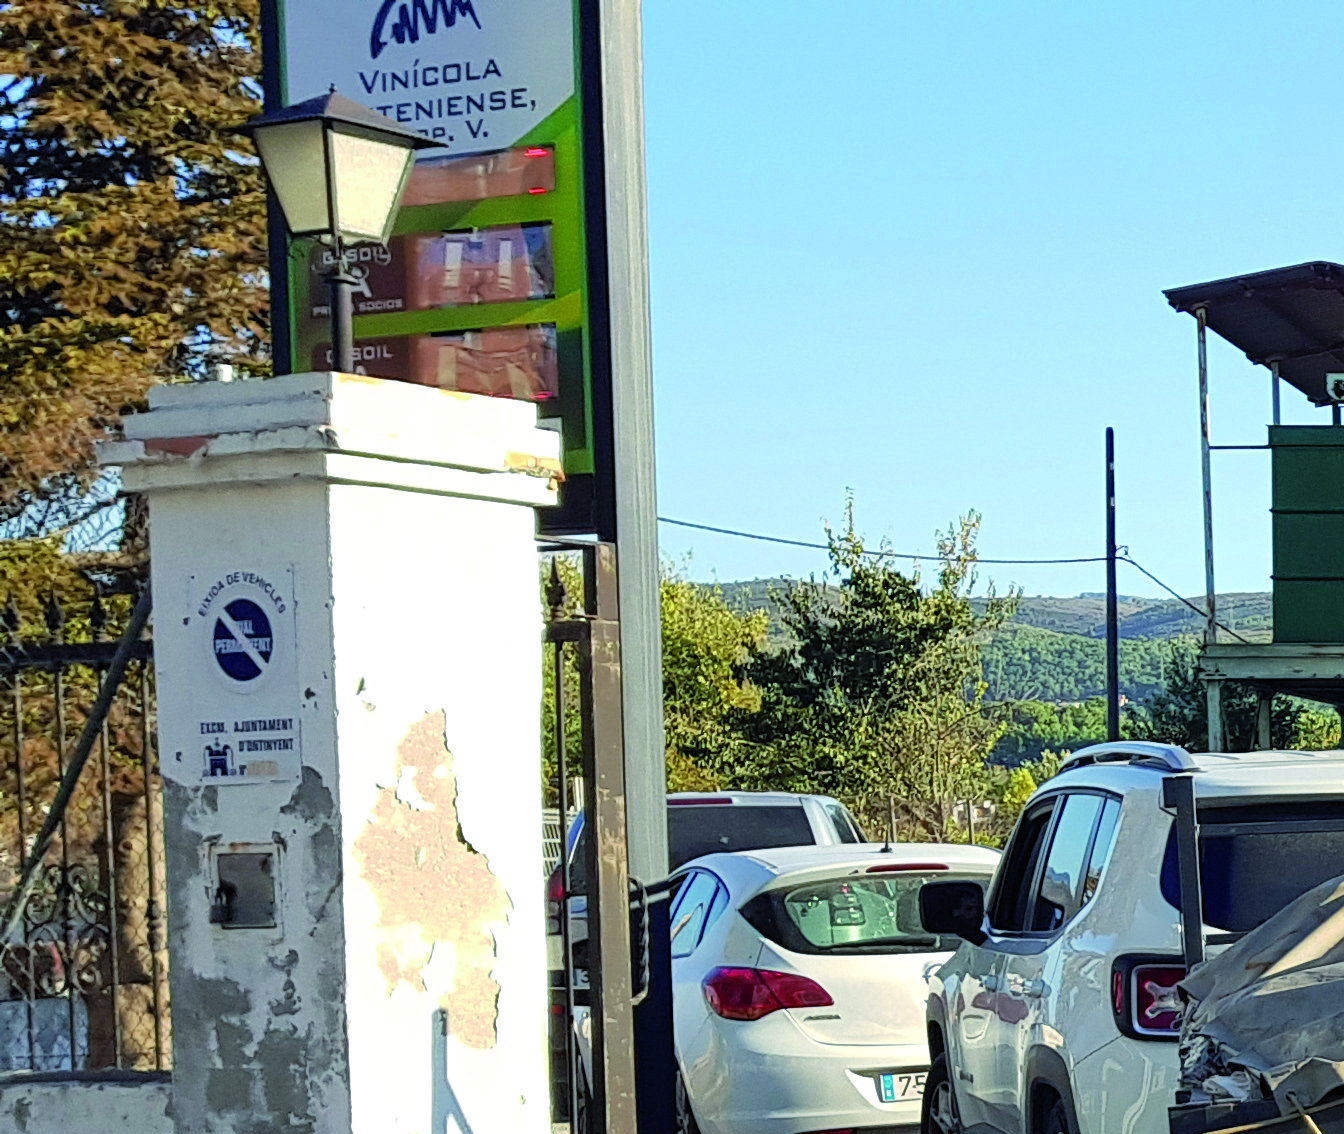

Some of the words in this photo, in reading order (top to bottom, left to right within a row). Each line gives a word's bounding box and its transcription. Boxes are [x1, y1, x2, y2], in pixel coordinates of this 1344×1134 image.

[358, 59, 502, 94] VINÍCOLA
[370, 88, 536, 123] TENIENSE,
[465, 119, 489, 139] V.
[322, 247, 390, 264] GSOIL
[226, 572, 240, 585] DE
